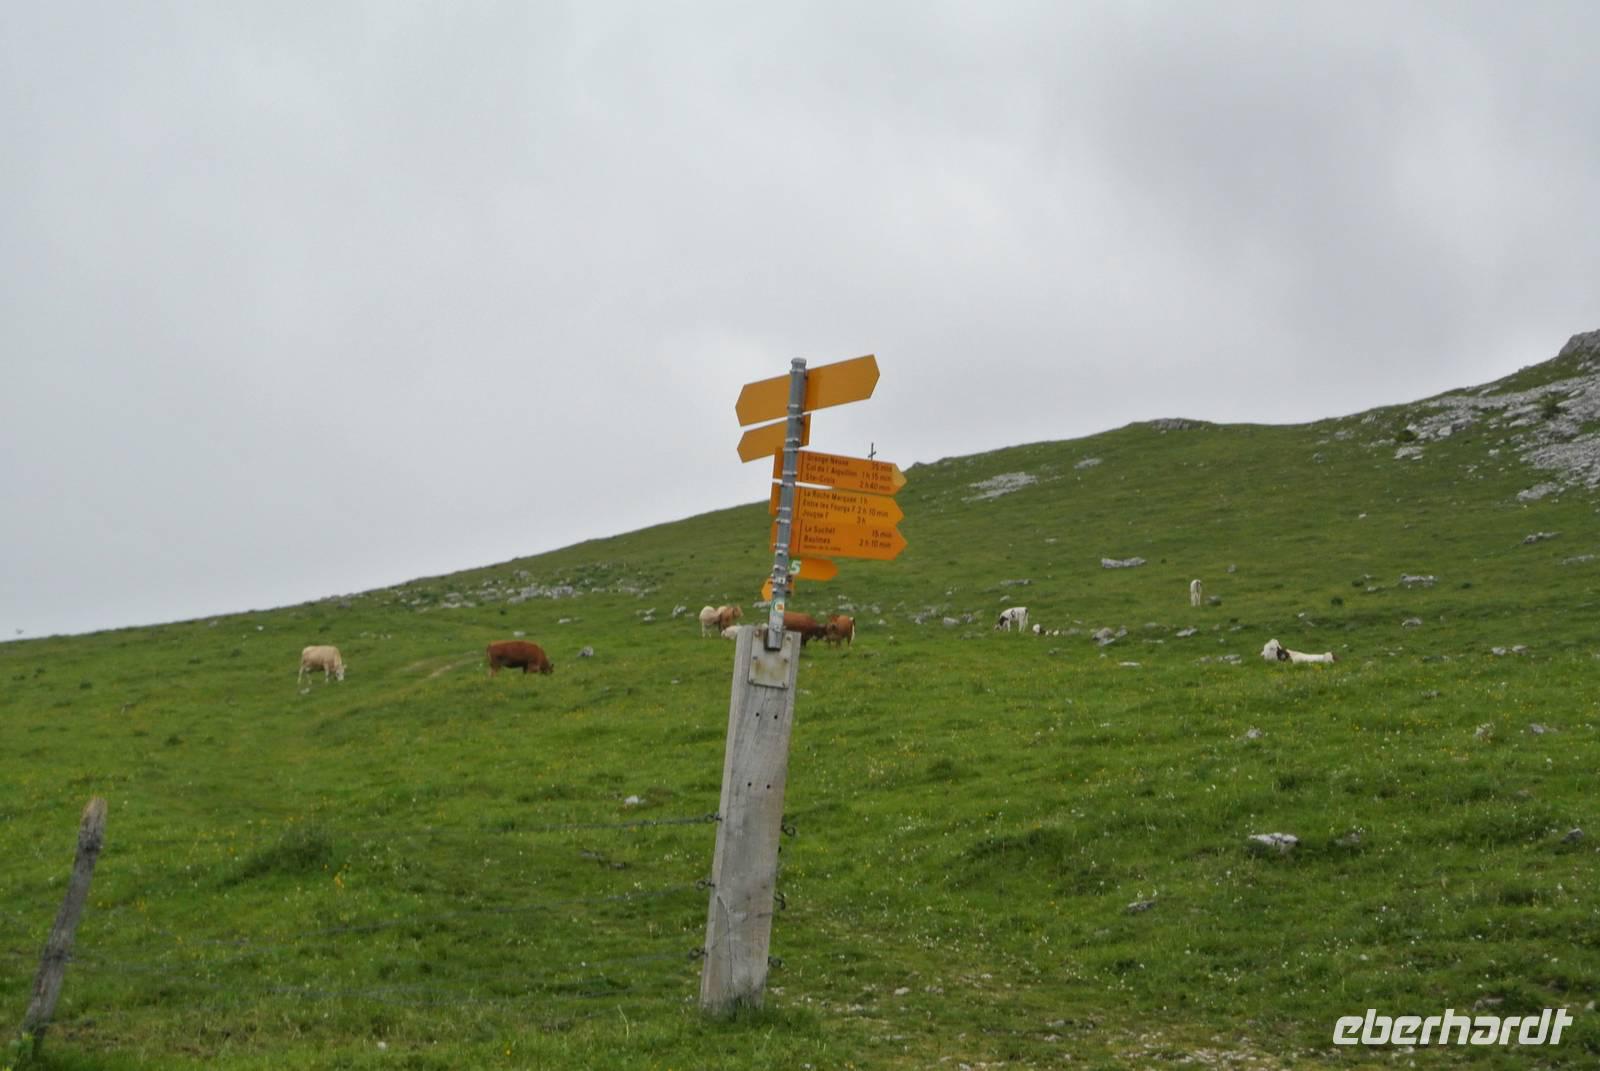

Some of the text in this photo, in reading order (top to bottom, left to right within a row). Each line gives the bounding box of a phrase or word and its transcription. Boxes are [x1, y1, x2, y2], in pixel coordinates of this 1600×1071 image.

[814, 526, 835, 535] Suchet
[804, 534, 831, 544] Baulmes
[790, 560, 802, 574] 5
